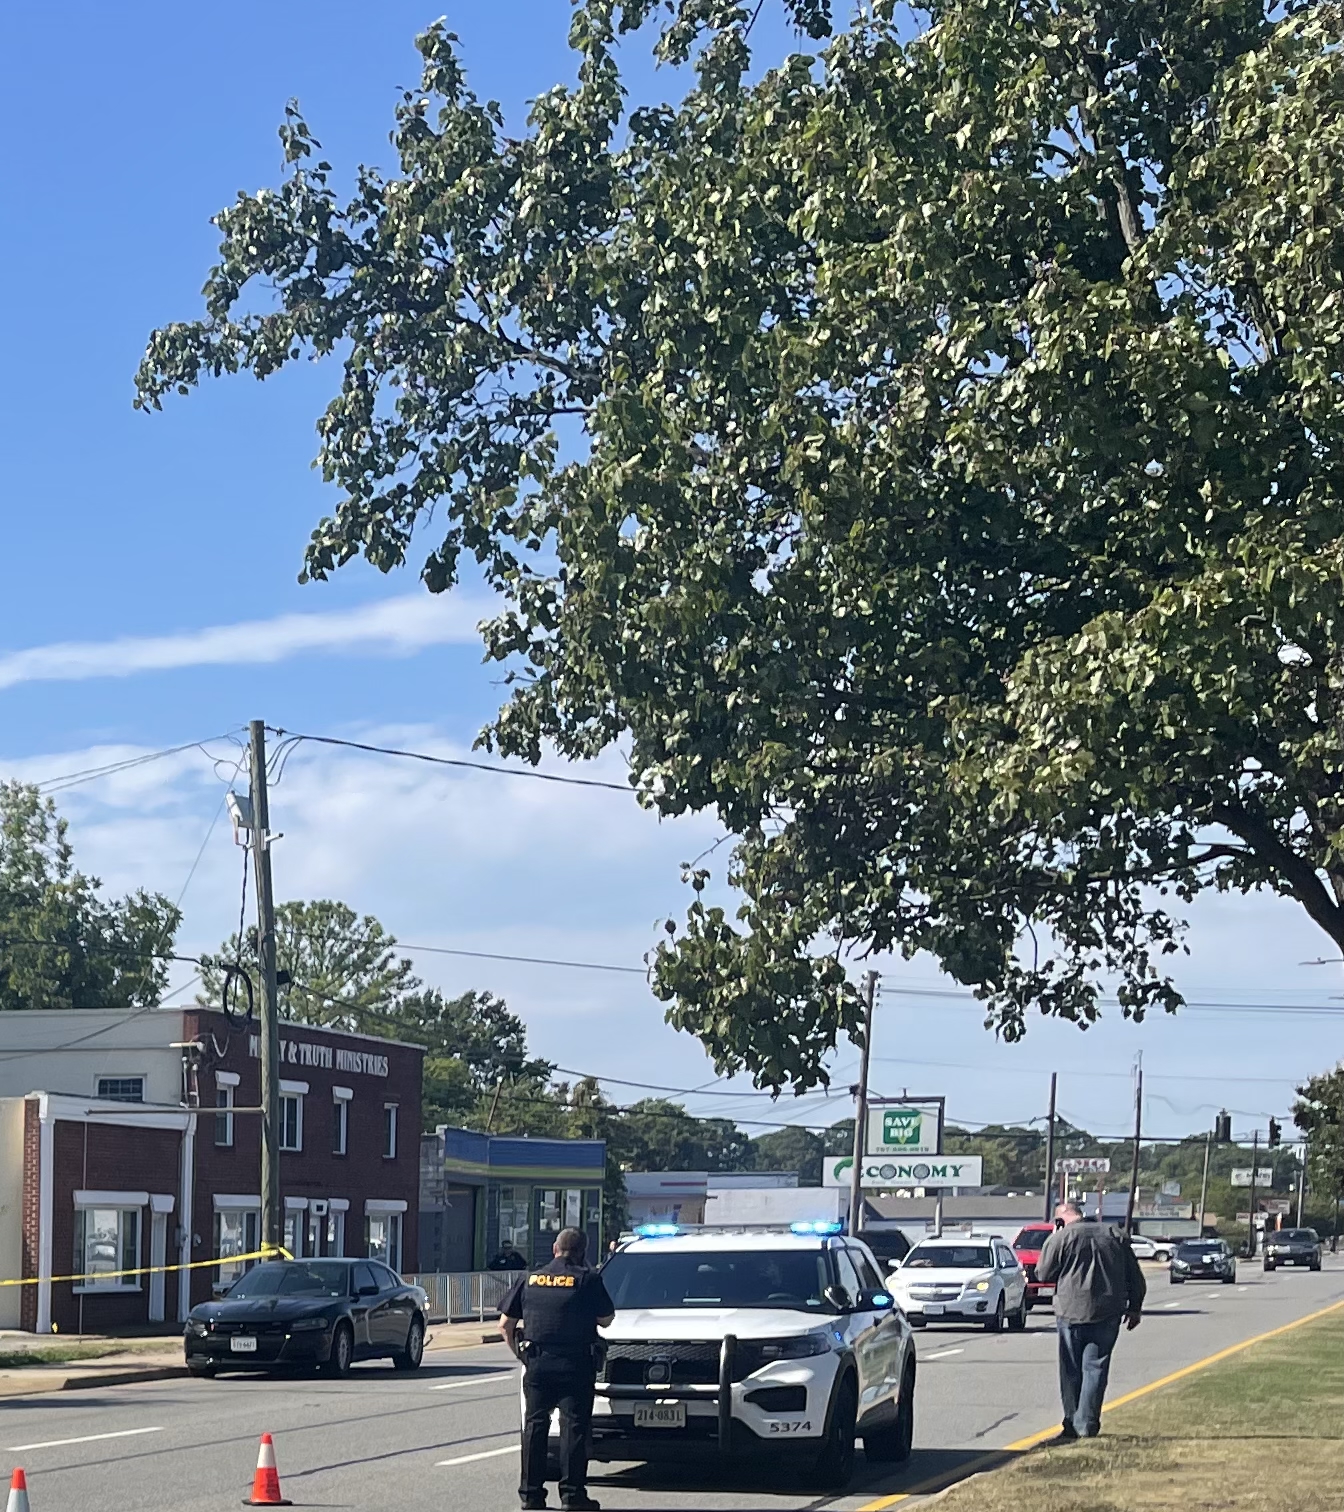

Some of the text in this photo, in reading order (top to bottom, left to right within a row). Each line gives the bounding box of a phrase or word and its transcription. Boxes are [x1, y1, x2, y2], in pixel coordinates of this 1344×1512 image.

[288, 1041, 297, 1064] &
[298, 1042, 333, 1069] TRUTH
[335, 1048, 388, 1077] MINISTRIES
[860, 1163, 964, 1180] CONOMY
[529, 1275, 575, 1287] POLICE
[769, 1420, 812, 1433] 5374
